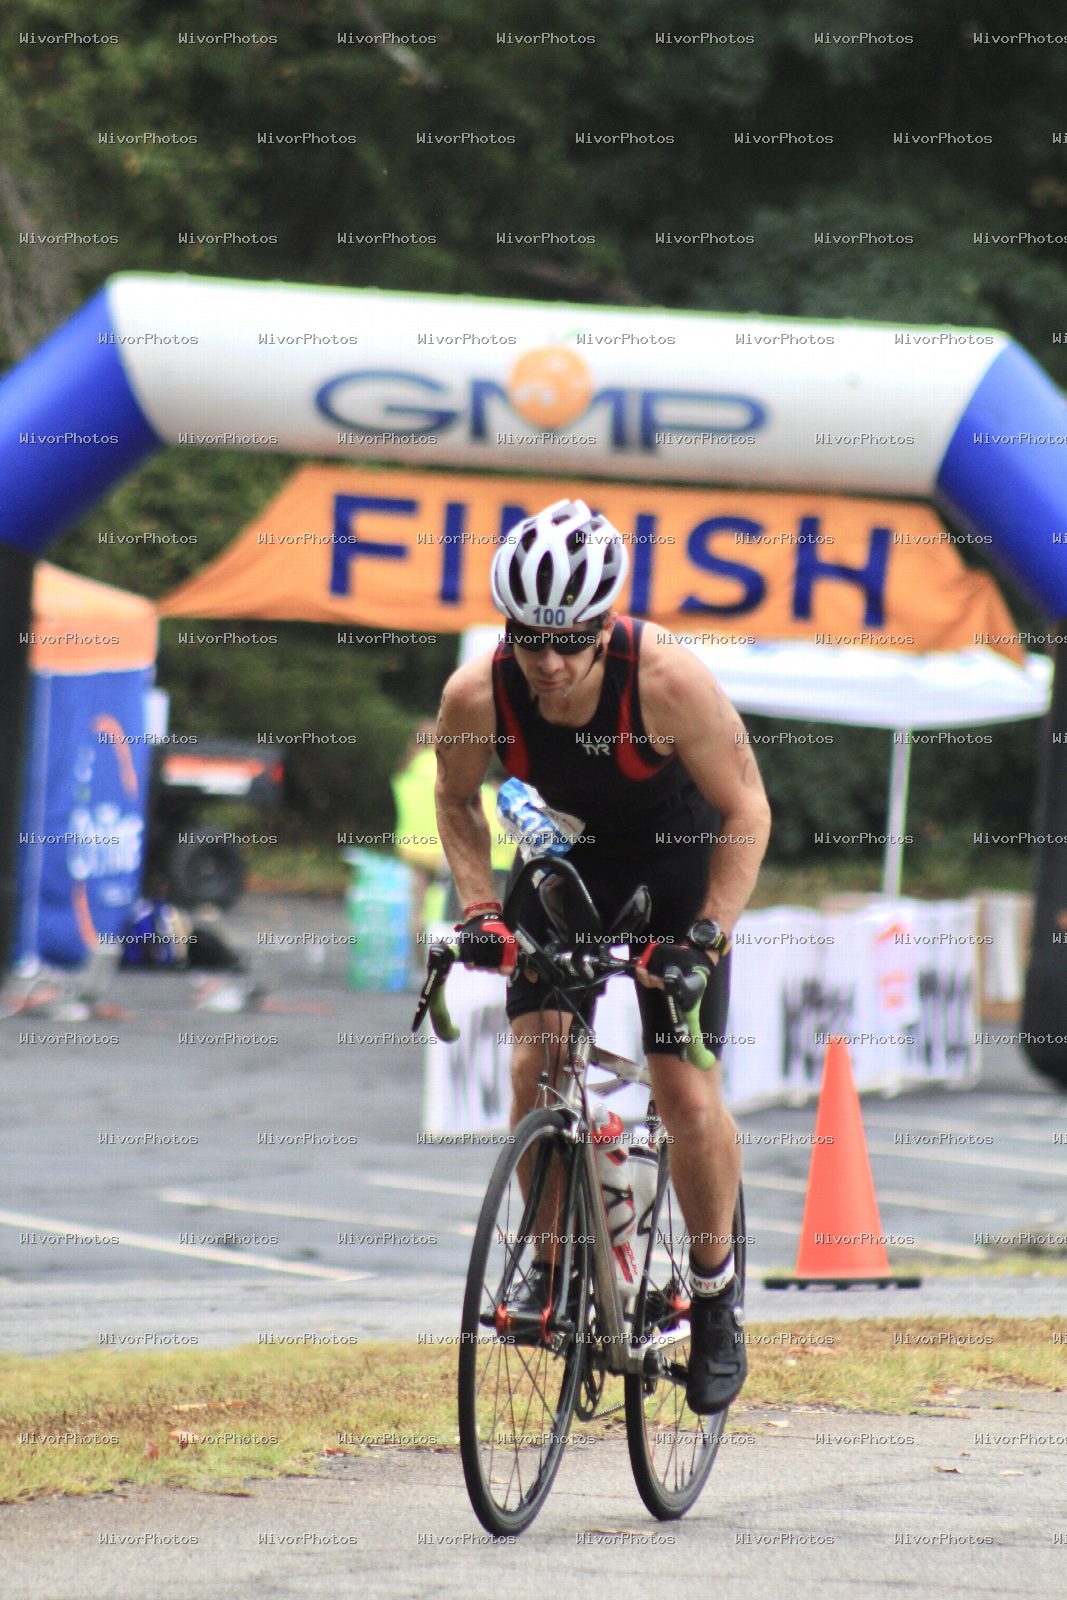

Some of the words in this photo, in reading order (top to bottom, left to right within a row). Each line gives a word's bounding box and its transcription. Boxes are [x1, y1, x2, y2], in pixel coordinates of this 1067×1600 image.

[330, 493, 892, 629] FIISH
[533, 607, 566, 627] 100
[582, 743, 611, 756] TYR
